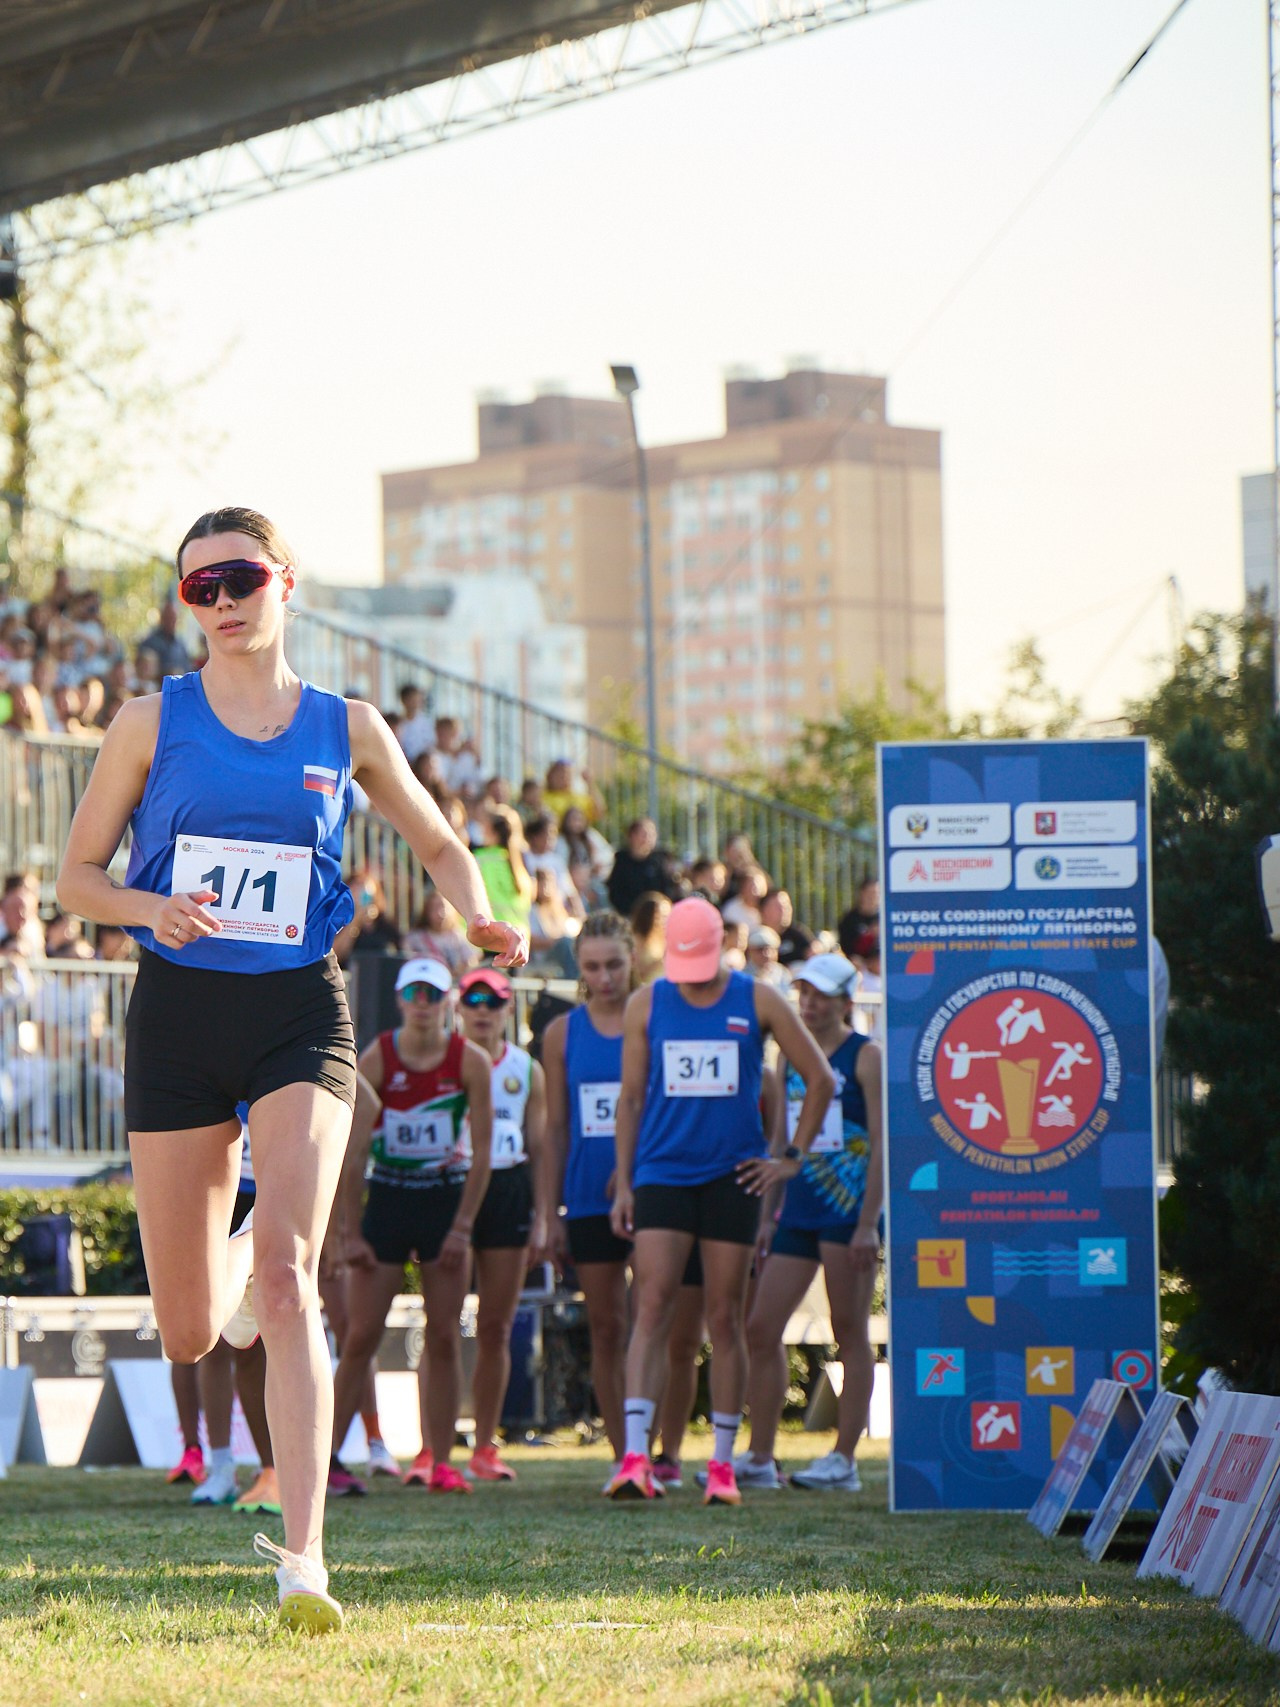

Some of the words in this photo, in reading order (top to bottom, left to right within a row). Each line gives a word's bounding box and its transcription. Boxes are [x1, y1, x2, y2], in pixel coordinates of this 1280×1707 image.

[932, 856, 994, 870] МОСКОВСКИЙ
[201, 865, 277, 912] 1/1
[891, 911, 941, 923] КУБОК
[943, 909, 1025, 922] СОЮЗНОГО
[1028, 907, 1134, 921] ГОСУДАРСТВА
[893, 924, 915, 937] ПО
[918, 923, 1040, 937] СОВРЕМЕННОМУ
[1044, 922, 1137, 935] ПЯТИБОРЬЮ
[949, 940, 1027, 951] PENTATHLON
[1074, 938, 1108, 949] STATE
[1112, 938, 1137, 949] CUP
[1019, 971, 1036, 988] ПО
[678, 1056, 720, 1079] 3/1
[397, 1123, 437, 1145] 8/1
